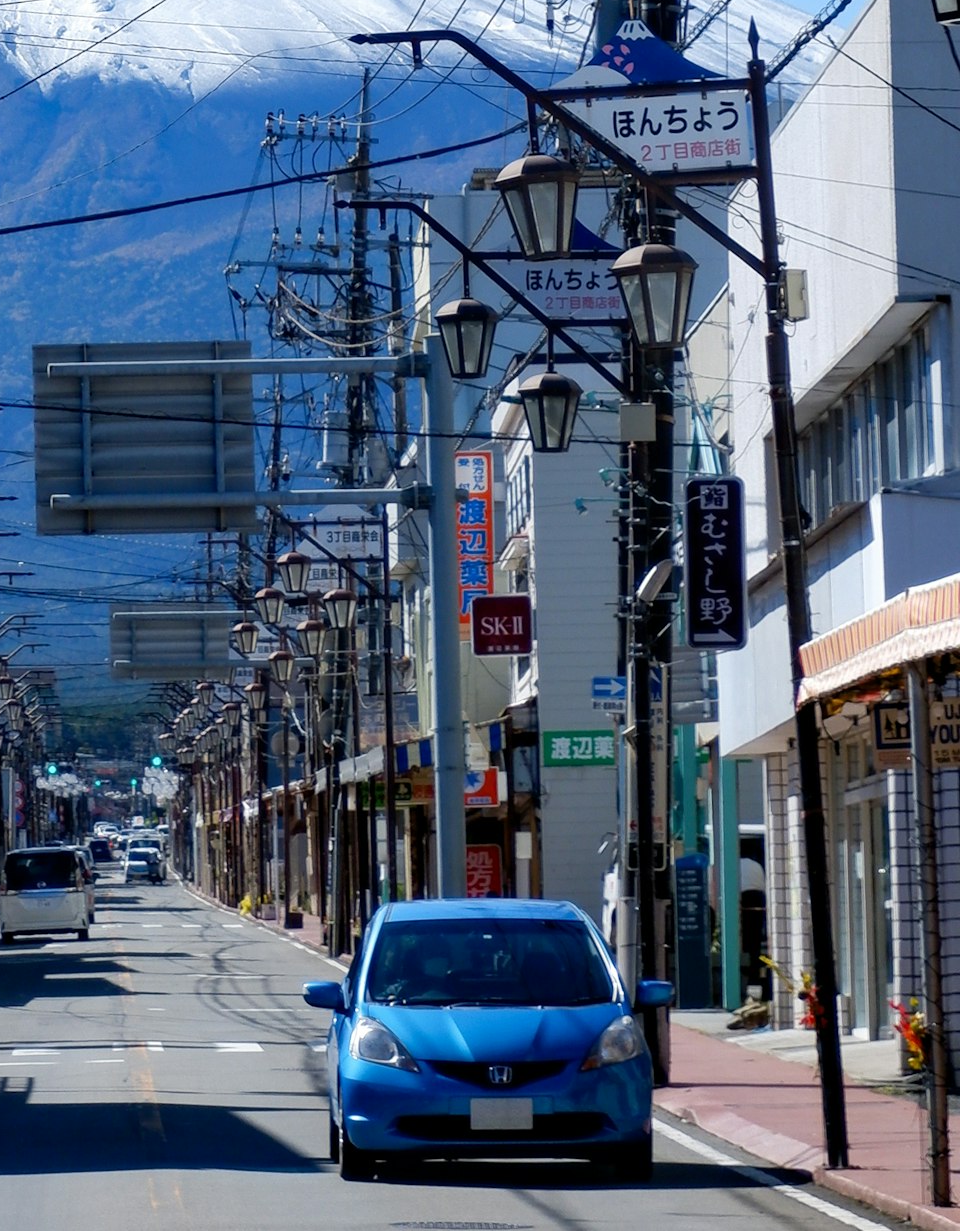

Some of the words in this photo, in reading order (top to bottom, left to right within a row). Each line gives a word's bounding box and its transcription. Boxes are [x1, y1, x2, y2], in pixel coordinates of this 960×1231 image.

[613, 100, 739, 138] ほんちょう
[641, 138, 741, 162] 2丁目商店街
[545, 295, 620, 309] 2丁目商店街
[700, 513, 733, 625] むさし野
[551, 736, 614, 761] 渡辺薬
